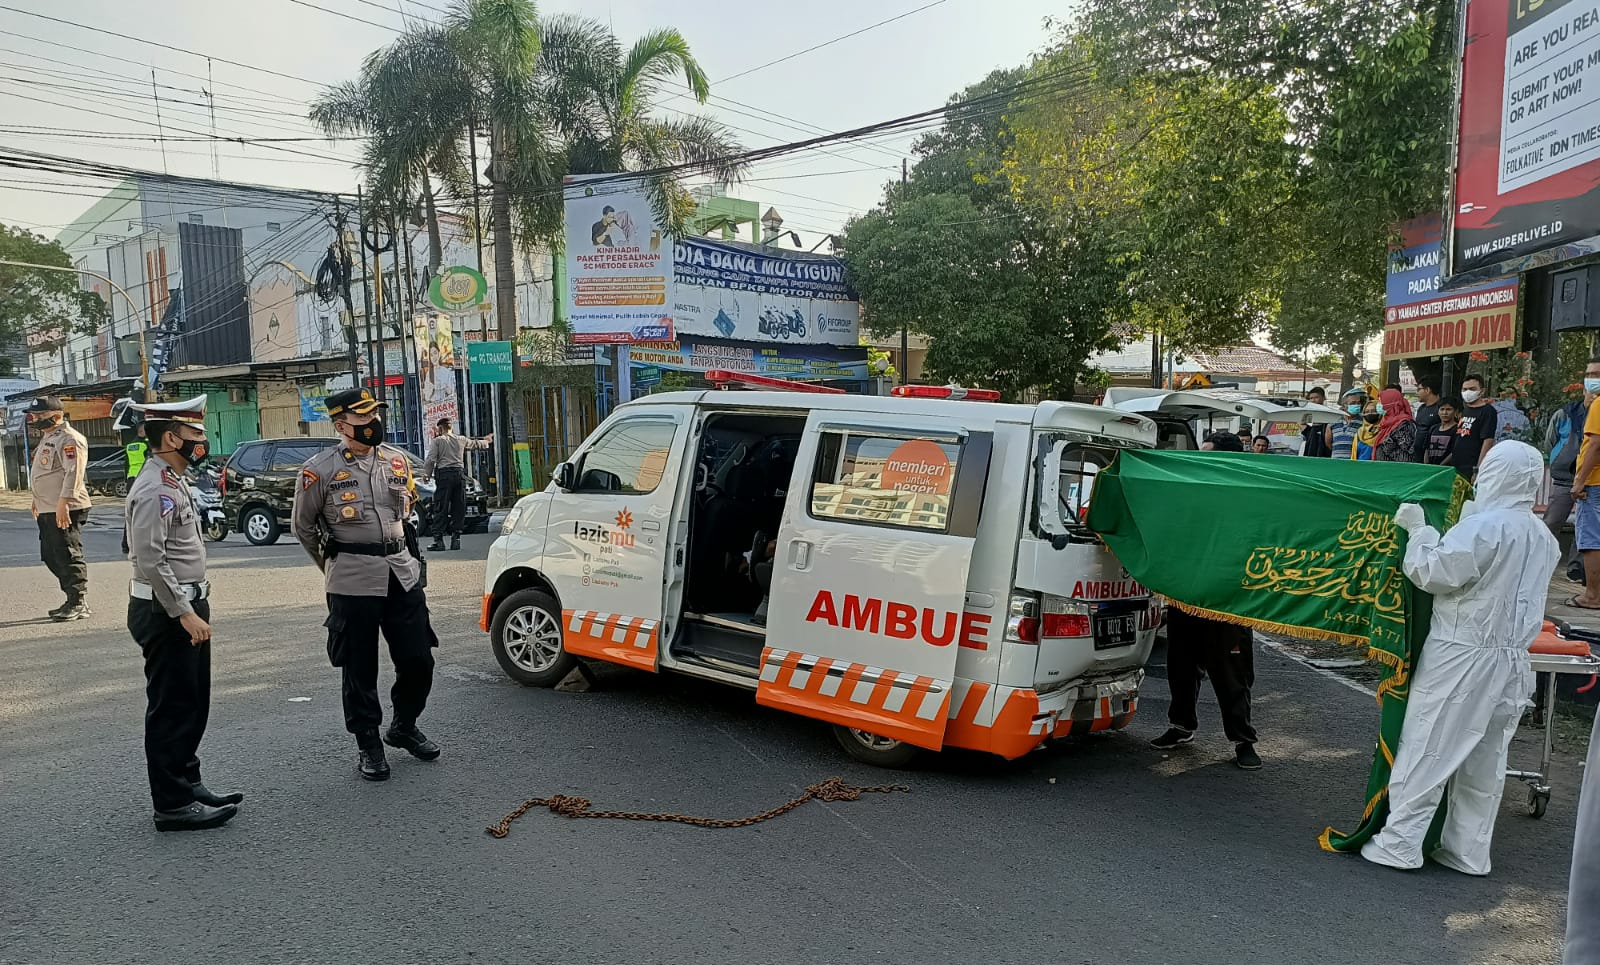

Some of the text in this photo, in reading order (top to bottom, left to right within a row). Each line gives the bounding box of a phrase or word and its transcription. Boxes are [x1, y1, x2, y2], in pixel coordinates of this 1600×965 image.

[1513, 40, 1539, 67] ARE
[1542, 23, 1569, 50] YOU
[1572, 7, 1600, 35] REA
[1511, 75, 1550, 106] SUBMIT
[1553, 58, 1584, 85] YOUR
[1509, 78, 1582, 123] OR ART NOW!
[1505, 147, 1545, 175] FOLKATIVE
[1549, 137, 1570, 158] IDN
[1507, 144, 1521, 155] MEDIA
[1463, 220, 1563, 260] WWW.SUPERLIVE.ID
[576, 253, 661, 263] PAKET PERSALINAN
[614, 246, 640, 254] HADIR
[583, 261, 655, 270] SC METODE ERACS
[710, 250, 762, 273] DANA
[762, 259, 847, 283] MULTIGUN
[730, 281, 766, 292] BPKB
[769, 286, 814, 298] MOTOR
[817, 291, 851, 301] ANDA
[1407, 277, 1432, 295] PADA
[1397, 288, 1514, 320] YAMAHA CENTER PERTAMA DI INDONESIA
[1385, 312, 1512, 355] HARPINDO JAYA
[644, 353, 666, 363] MOTOR
[667, 356, 684, 365] ANDA
[692, 344, 754, 359] LANGSUNG CAIR
[691, 357, 715, 369] TANPA
[716, 360, 756, 371] POTONGAN
[887, 459, 947, 476] memberi
[893, 481, 938, 494] negeri
[905, 475, 931, 485] untuk
[574, 520, 636, 547] lazismu
[600, 545, 613, 554] pati
